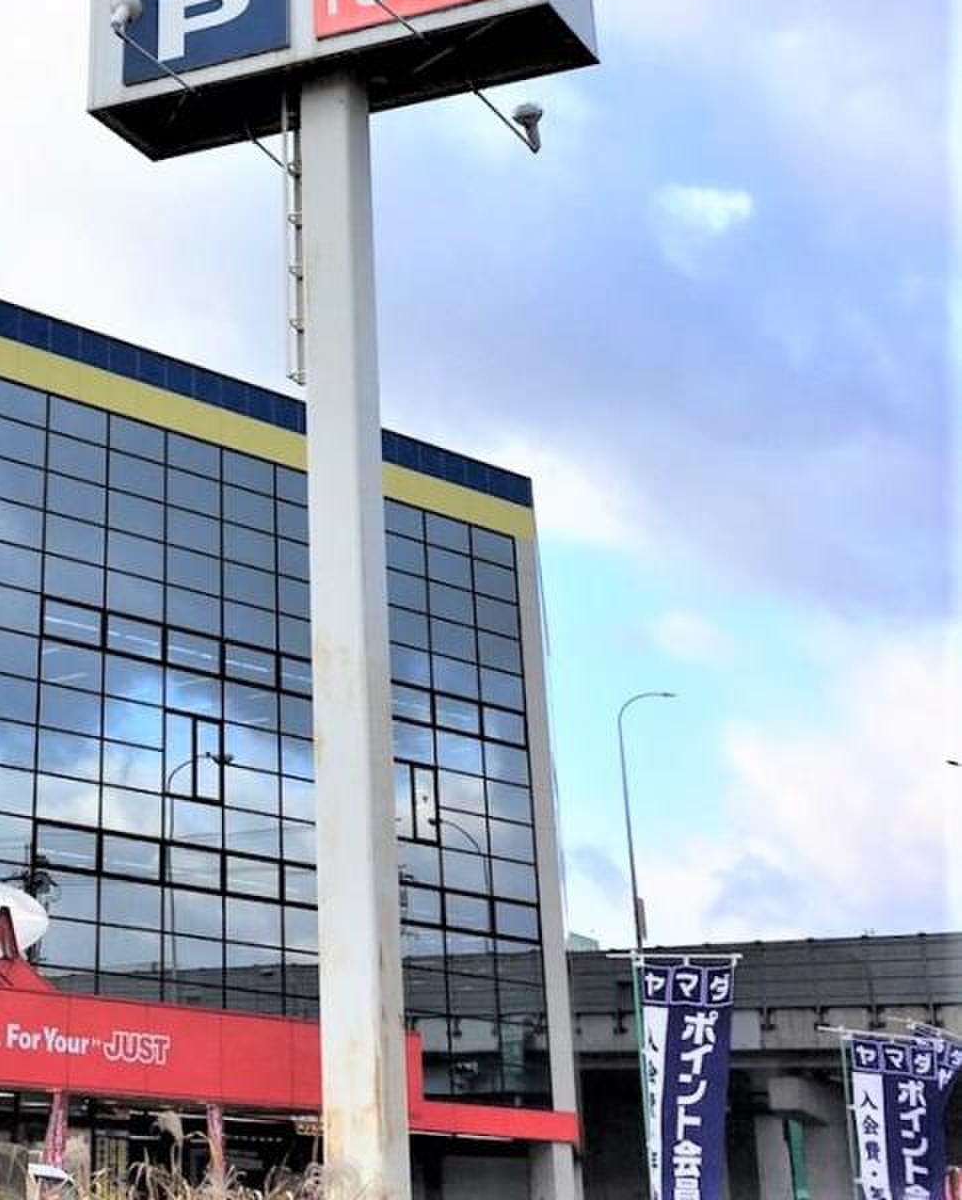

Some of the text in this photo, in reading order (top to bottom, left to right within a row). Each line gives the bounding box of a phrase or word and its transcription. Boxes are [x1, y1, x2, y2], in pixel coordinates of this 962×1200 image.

[644, 972, 731, 1001] ヤマダ
[6, 1023, 41, 1050] For
[43, 1026, 90, 1055] Your
[103, 1030, 171, 1066] JUST
[855, 1045, 932, 1074] ヤマダ
